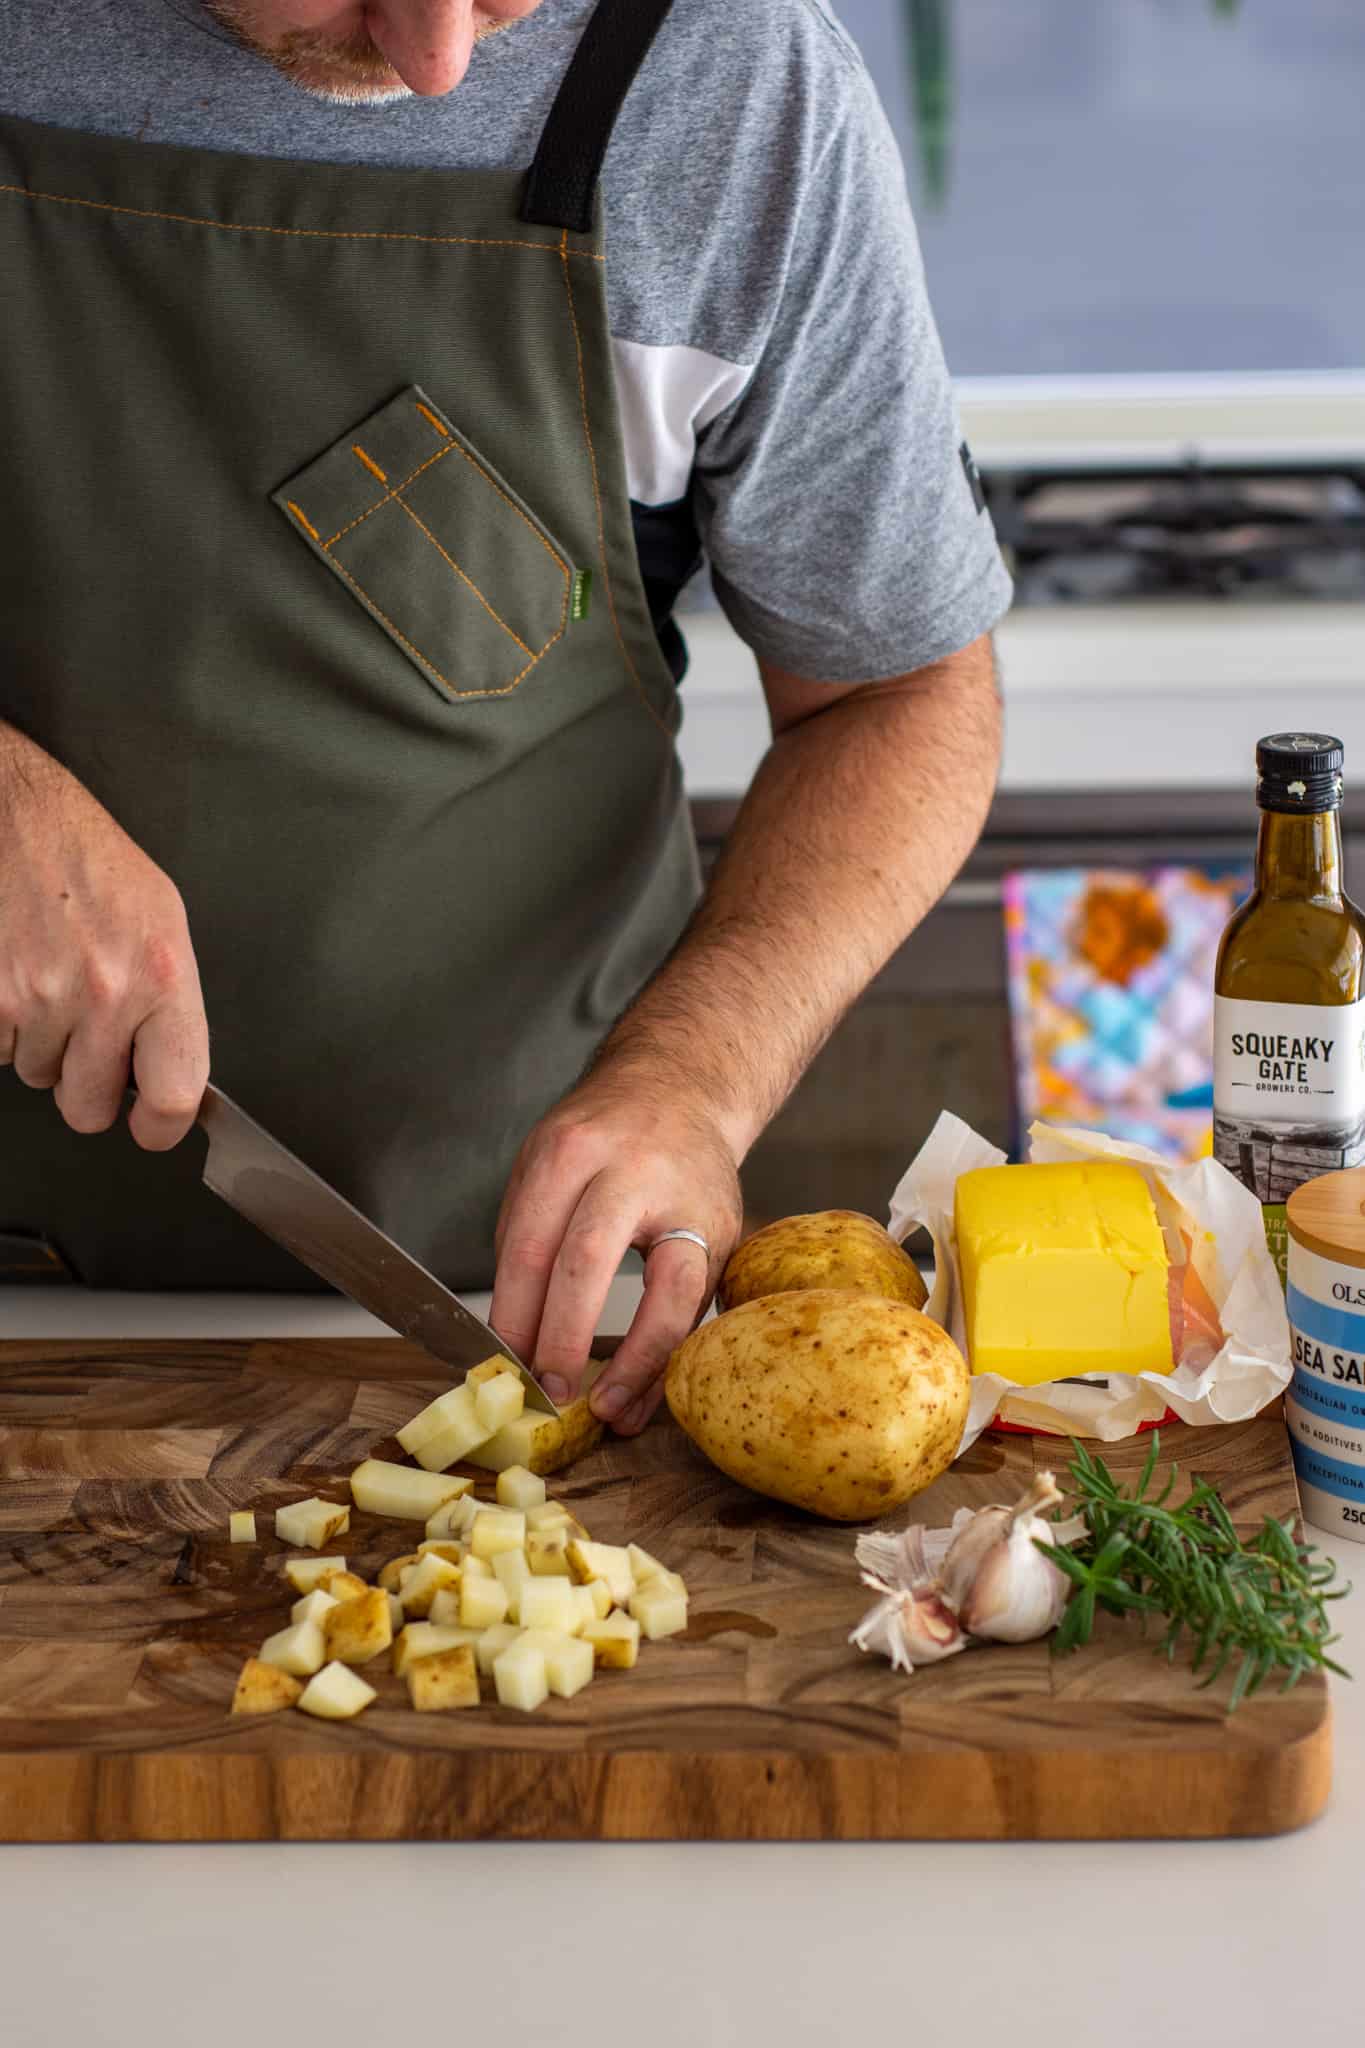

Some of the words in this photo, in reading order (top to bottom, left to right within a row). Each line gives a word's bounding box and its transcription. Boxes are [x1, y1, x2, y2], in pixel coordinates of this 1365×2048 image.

[1231, 1032, 1334, 1063] SQUEAKY
[1258, 1060, 1308, 1083] GATE
[1255, 1082, 1295, 1094] GROWERS
[1295, 1336, 1325, 1375] SEA
[1332, 1354, 1365, 1385] SA
[1300, 1421, 1310, 1433] NO
[1313, 1429, 1362, 1453] ADDITIVES
